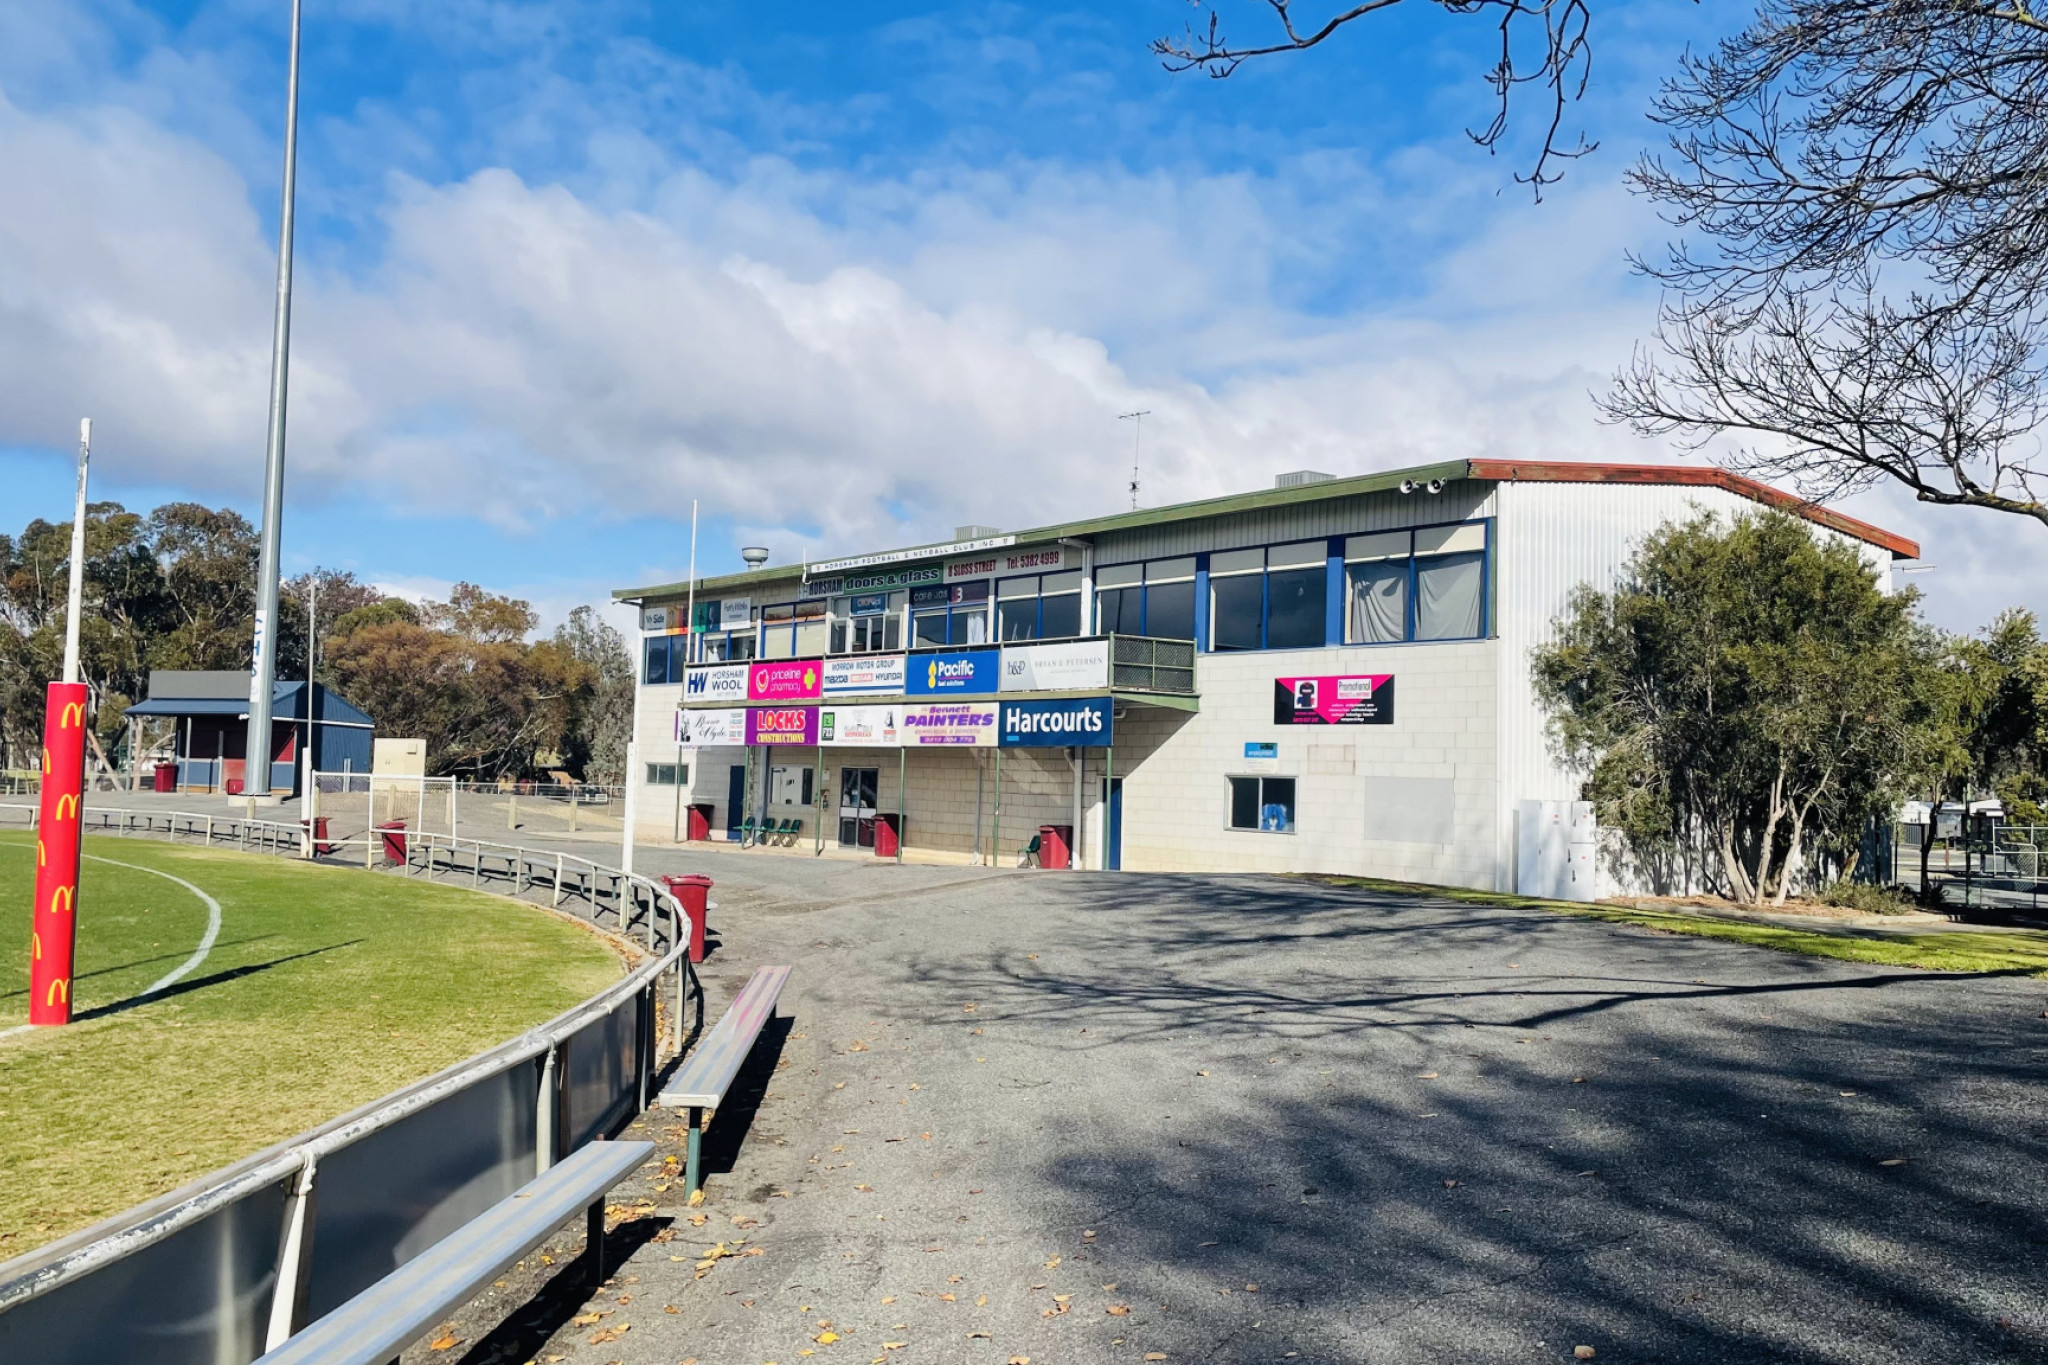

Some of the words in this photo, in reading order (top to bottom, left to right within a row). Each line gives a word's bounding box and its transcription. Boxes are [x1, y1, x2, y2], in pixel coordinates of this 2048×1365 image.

[862, 554, 900, 564] FOOTBALL
[913, 548, 948, 557] NETBALL
[953, 543, 975, 552] CLUB
[953, 563, 973, 577] SLOSS
[973, 559, 997, 574] STREET
[1007, 557, 1020, 569] Tel:
[1020, 553, 1039, 568] 5382
[1040, 551, 1059, 565] 4999
[809, 578, 843, 595] HORSHAM
[845, 575, 884, 590] doors
[887, 575, 897, 584] &
[900, 568, 939, 584] glass
[876, 659, 896, 669] GROUP
[938, 660, 975, 677] Pacific
[711, 669, 744, 680] HORSHAM
[770, 669, 801, 682] priceline
[875, 672, 903, 681] HYUNDAI
[687, 671, 709, 694] HW
[711, 679, 743, 691] WOOL
[770, 681, 801, 693] pharmacy
[929, 705, 971, 714] Bennett
[756, 710, 806, 732] LOCKS
[904, 713, 994, 727] PAINTERS
[1006, 706, 1102, 734] Harcourts
[756, 732, 806, 744] CONSTRUCTIONS
